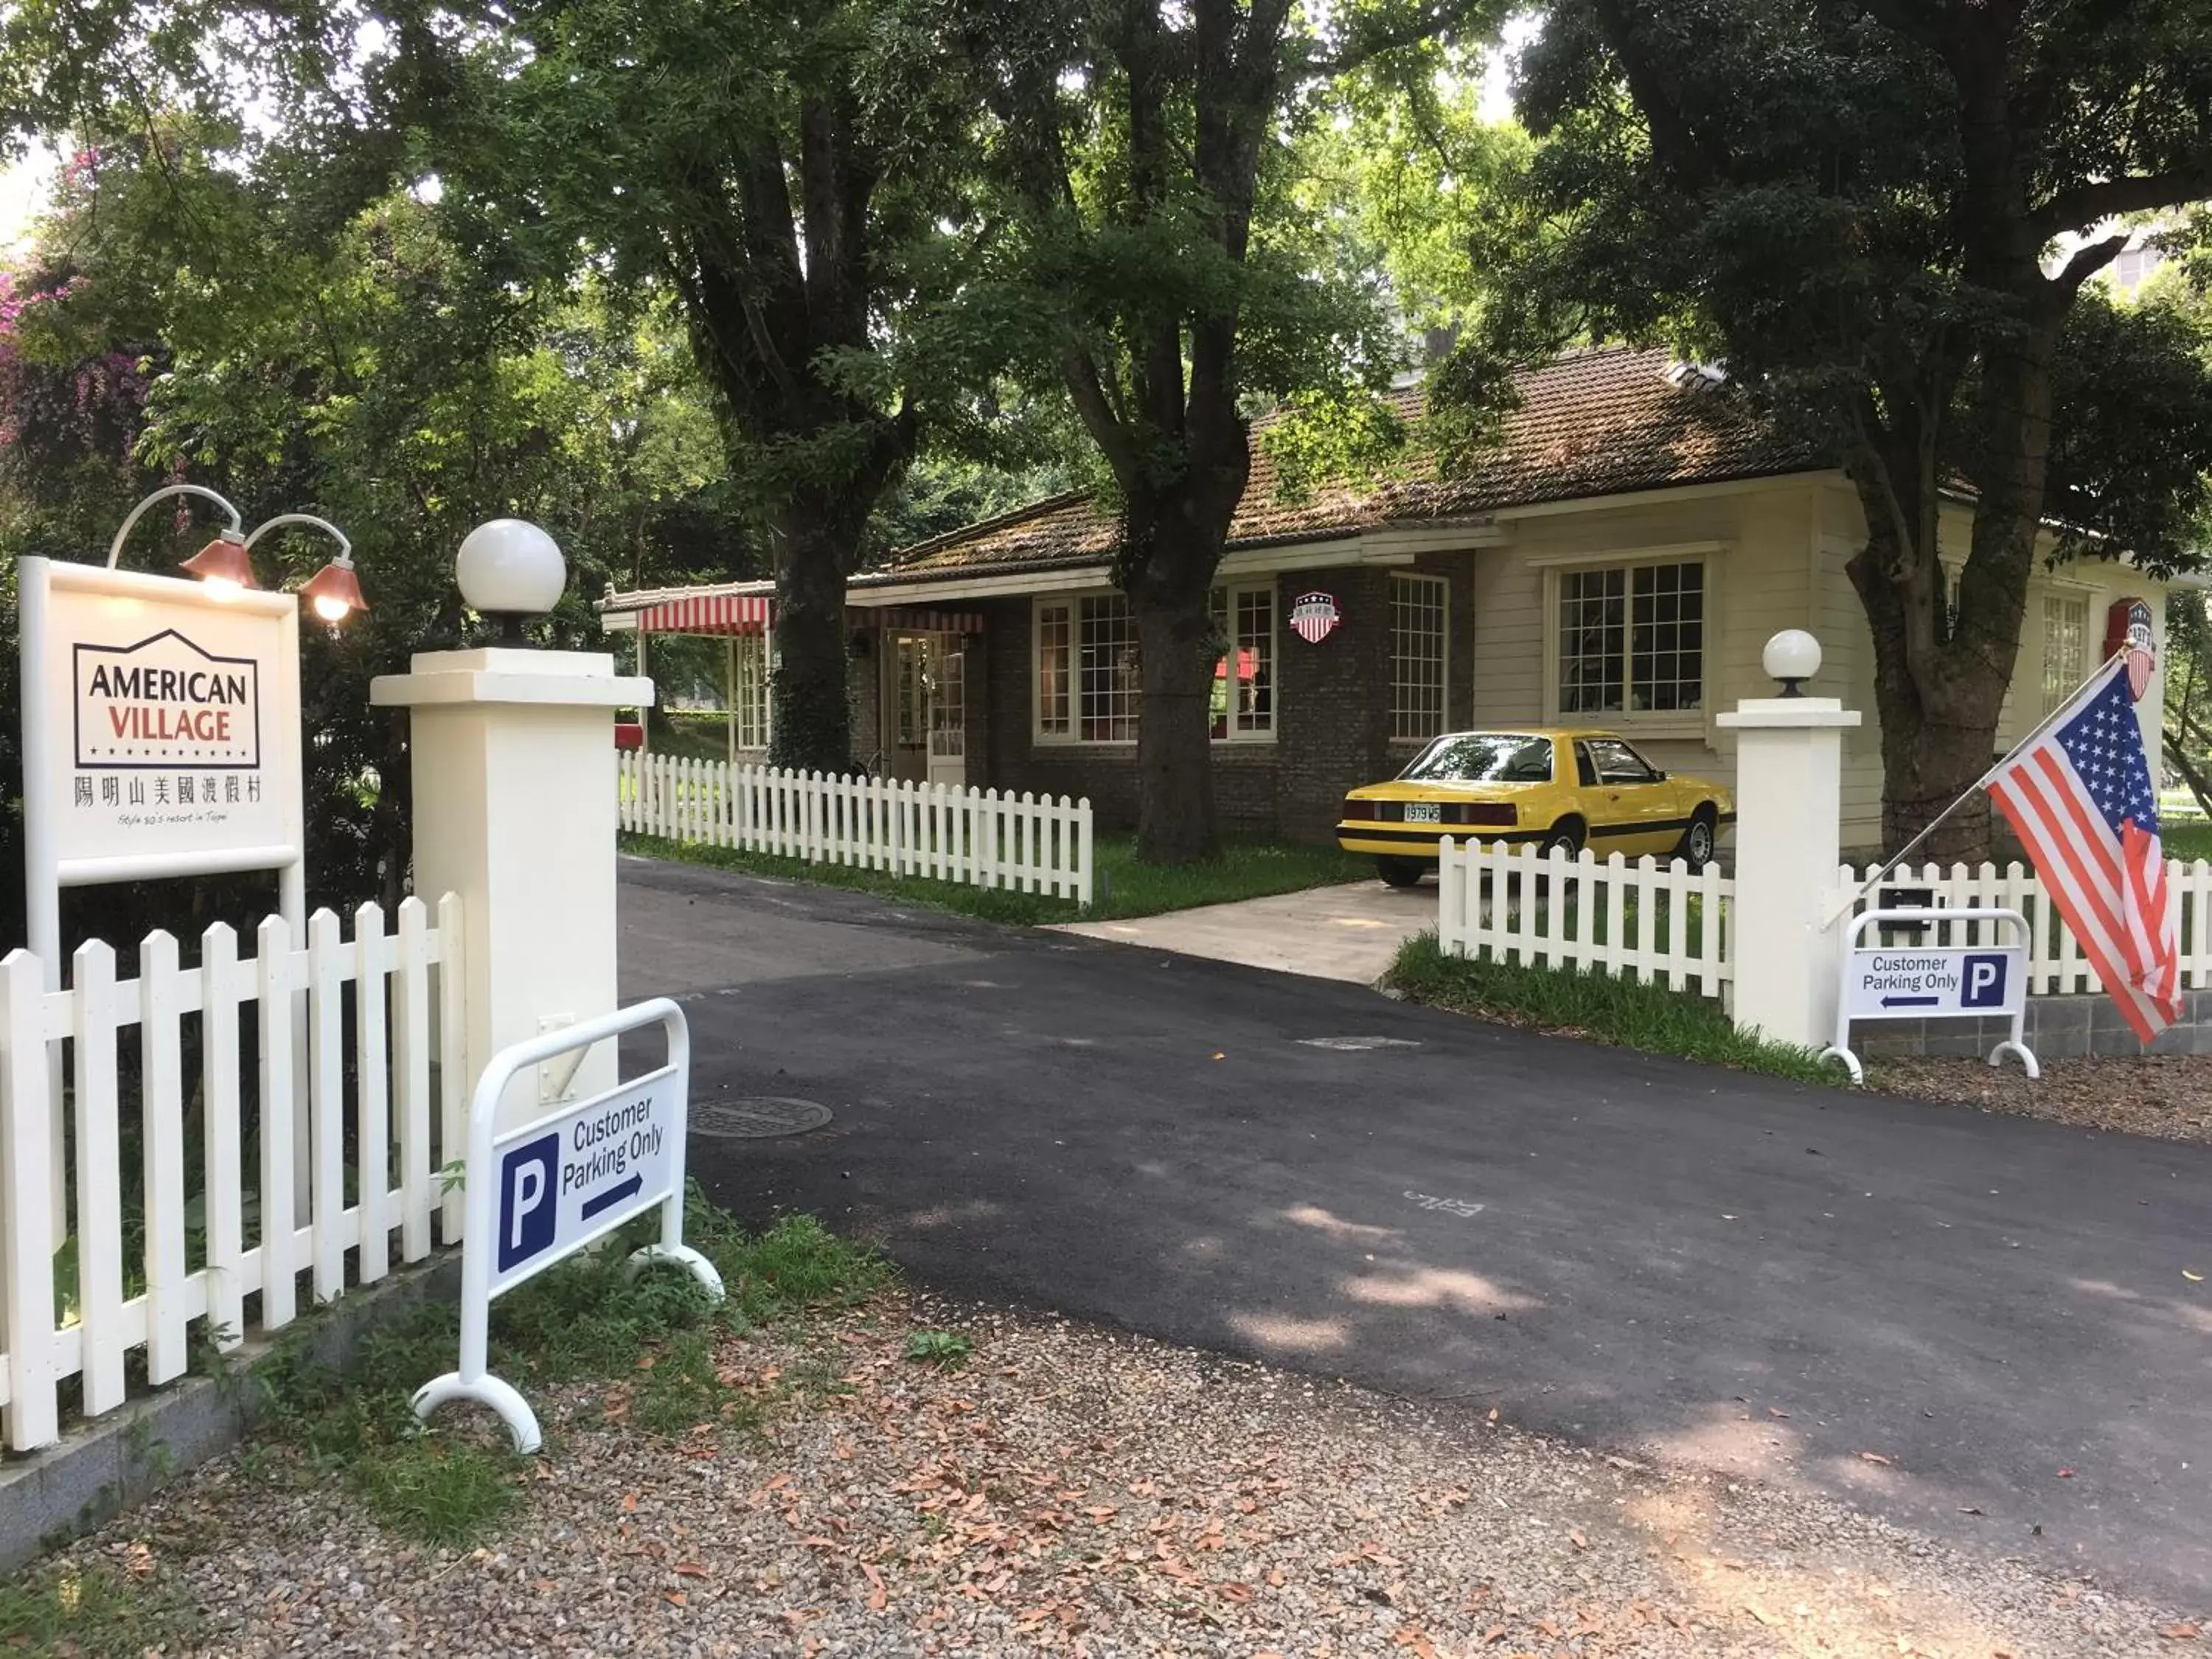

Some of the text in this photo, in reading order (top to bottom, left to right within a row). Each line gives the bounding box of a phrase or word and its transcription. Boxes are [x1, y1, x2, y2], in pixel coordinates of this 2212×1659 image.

[88, 664, 246, 705] AMERICAN
[108, 706, 231, 741] VILLAGE
[74, 775, 261, 807] 陽明山美國渡假村
[1863, 973, 1959, 992] Parking Only
[1872, 956, 1947, 972] Customer
[1969, 961, 1997, 1001] P
[574, 1096, 653, 1152] Customer
[563, 1123, 664, 1196] Parking Only
[511, 1158, 546, 1251] P
